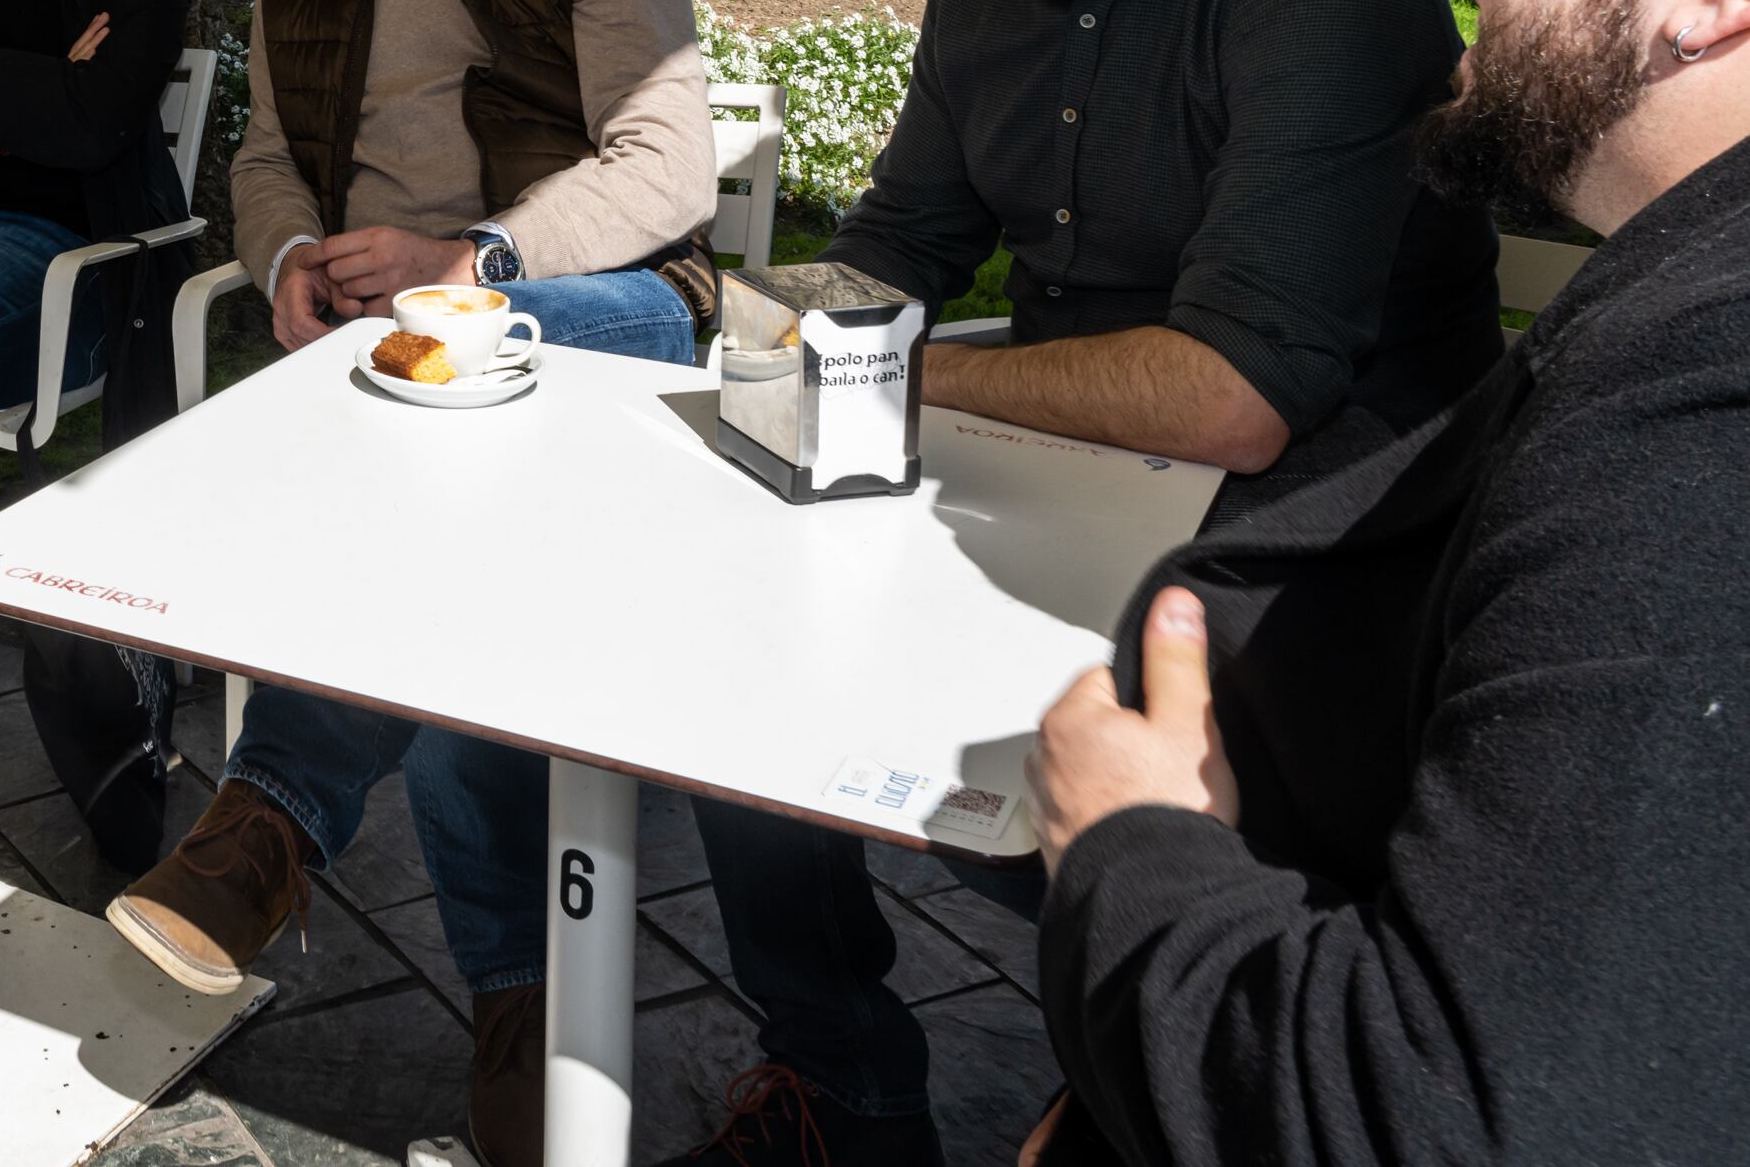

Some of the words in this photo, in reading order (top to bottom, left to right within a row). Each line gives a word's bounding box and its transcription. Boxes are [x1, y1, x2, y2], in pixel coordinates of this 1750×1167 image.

[866, 351, 898, 367] pan
[860, 375, 869, 384] o
[873, 365, 905, 384] can!
[560, 848, 595, 921] 6
